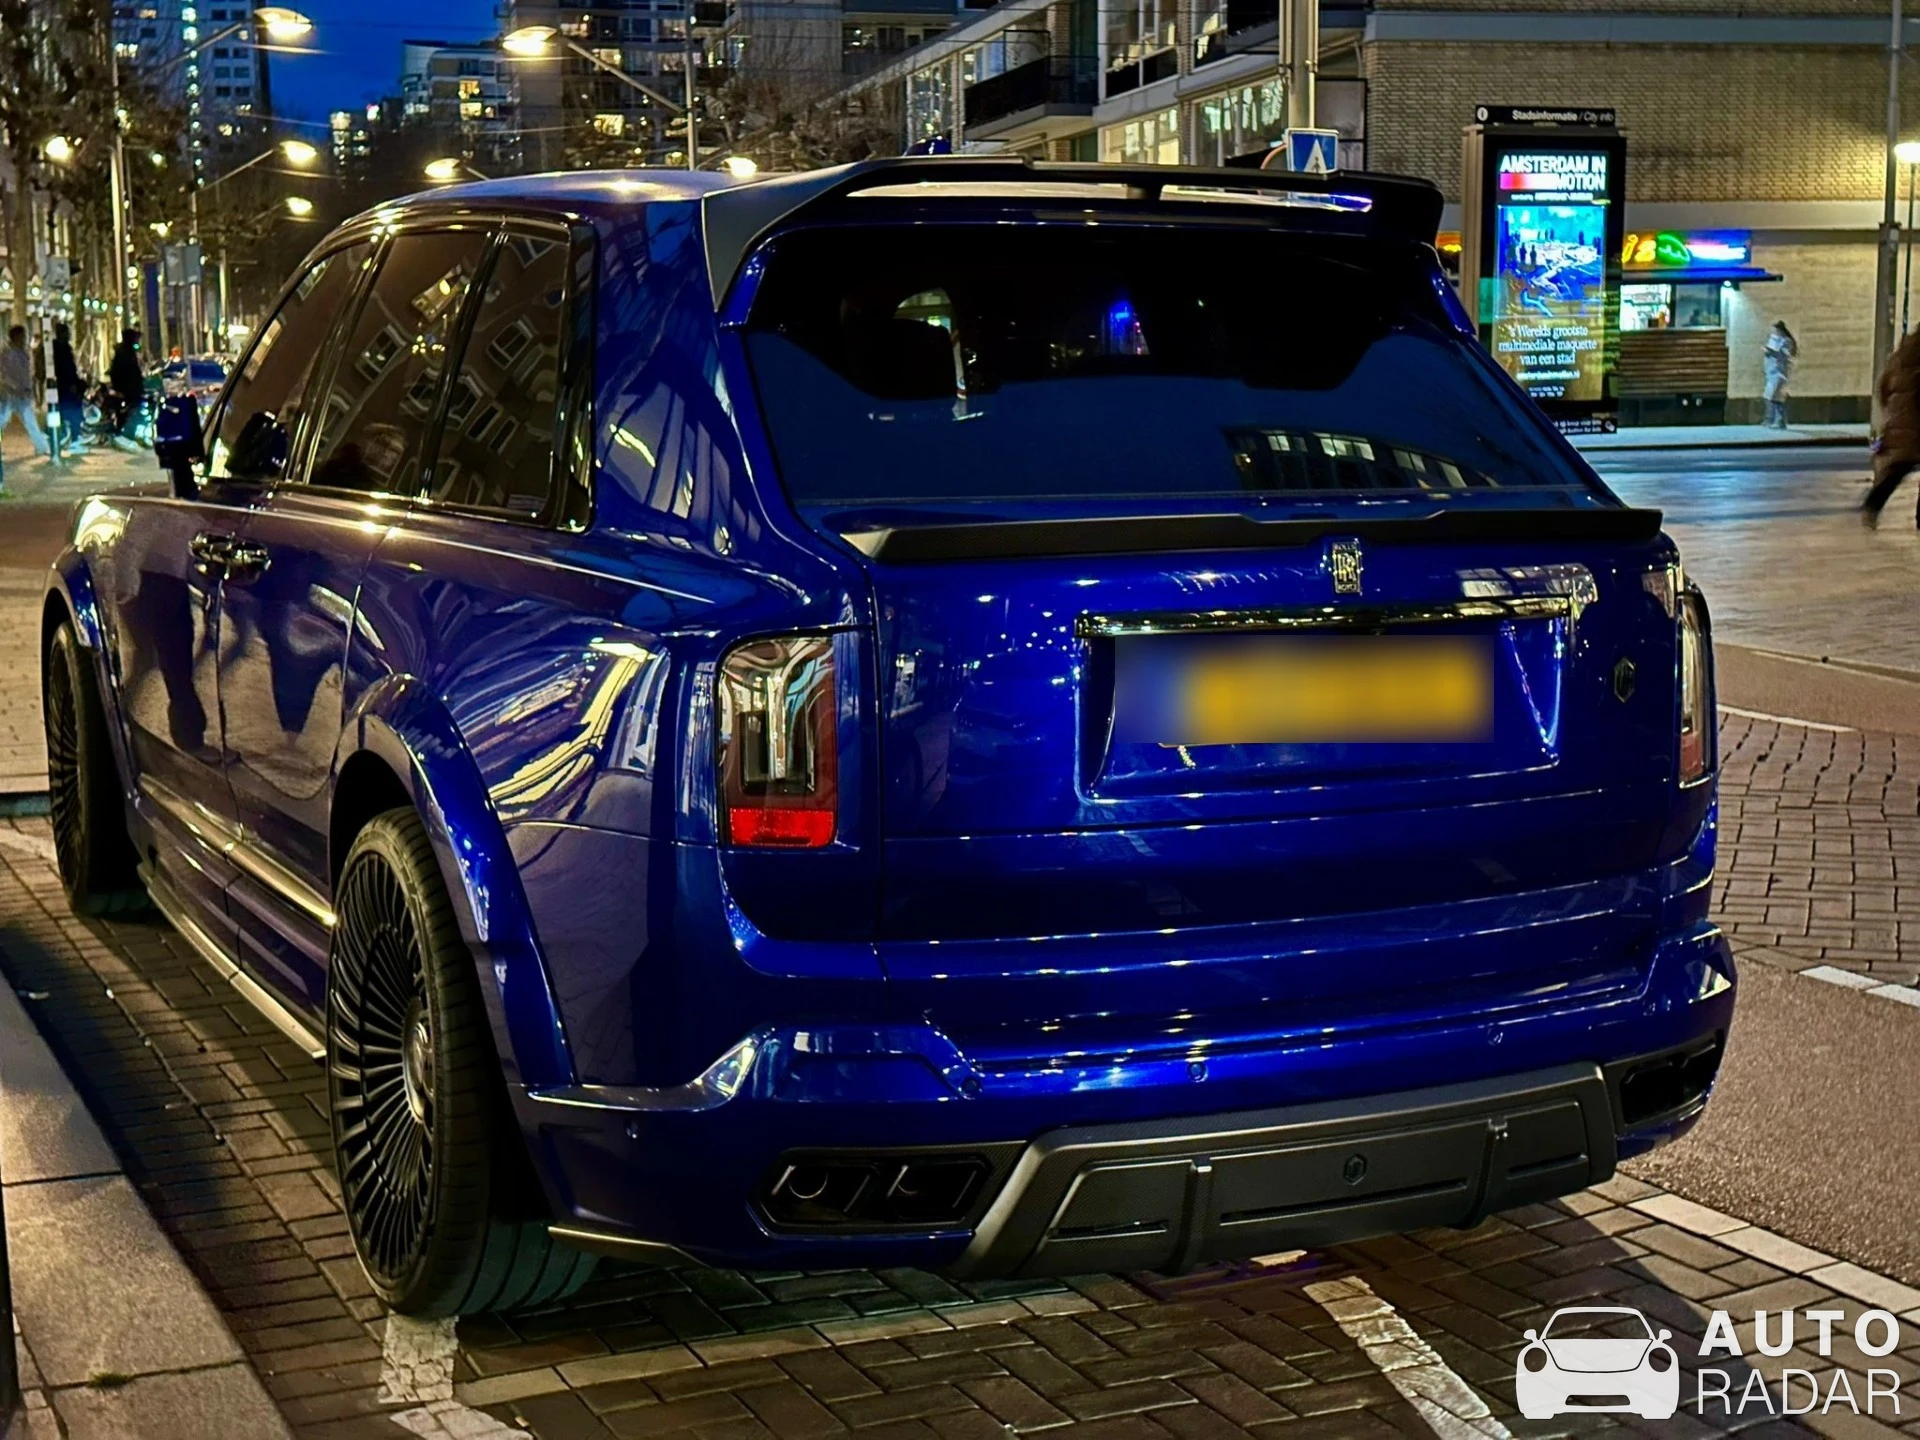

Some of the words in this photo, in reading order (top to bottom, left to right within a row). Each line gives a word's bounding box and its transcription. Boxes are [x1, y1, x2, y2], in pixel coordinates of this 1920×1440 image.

[1500, 155, 1589, 173] AMSTERDAM
[1591, 156, 1606, 173] IN
[1556, 173, 1606, 190] MOTION
[1520, 355, 1538, 366] van
[1539, 355, 1555, 365] een
[1556, 352, 1576, 365] stad
